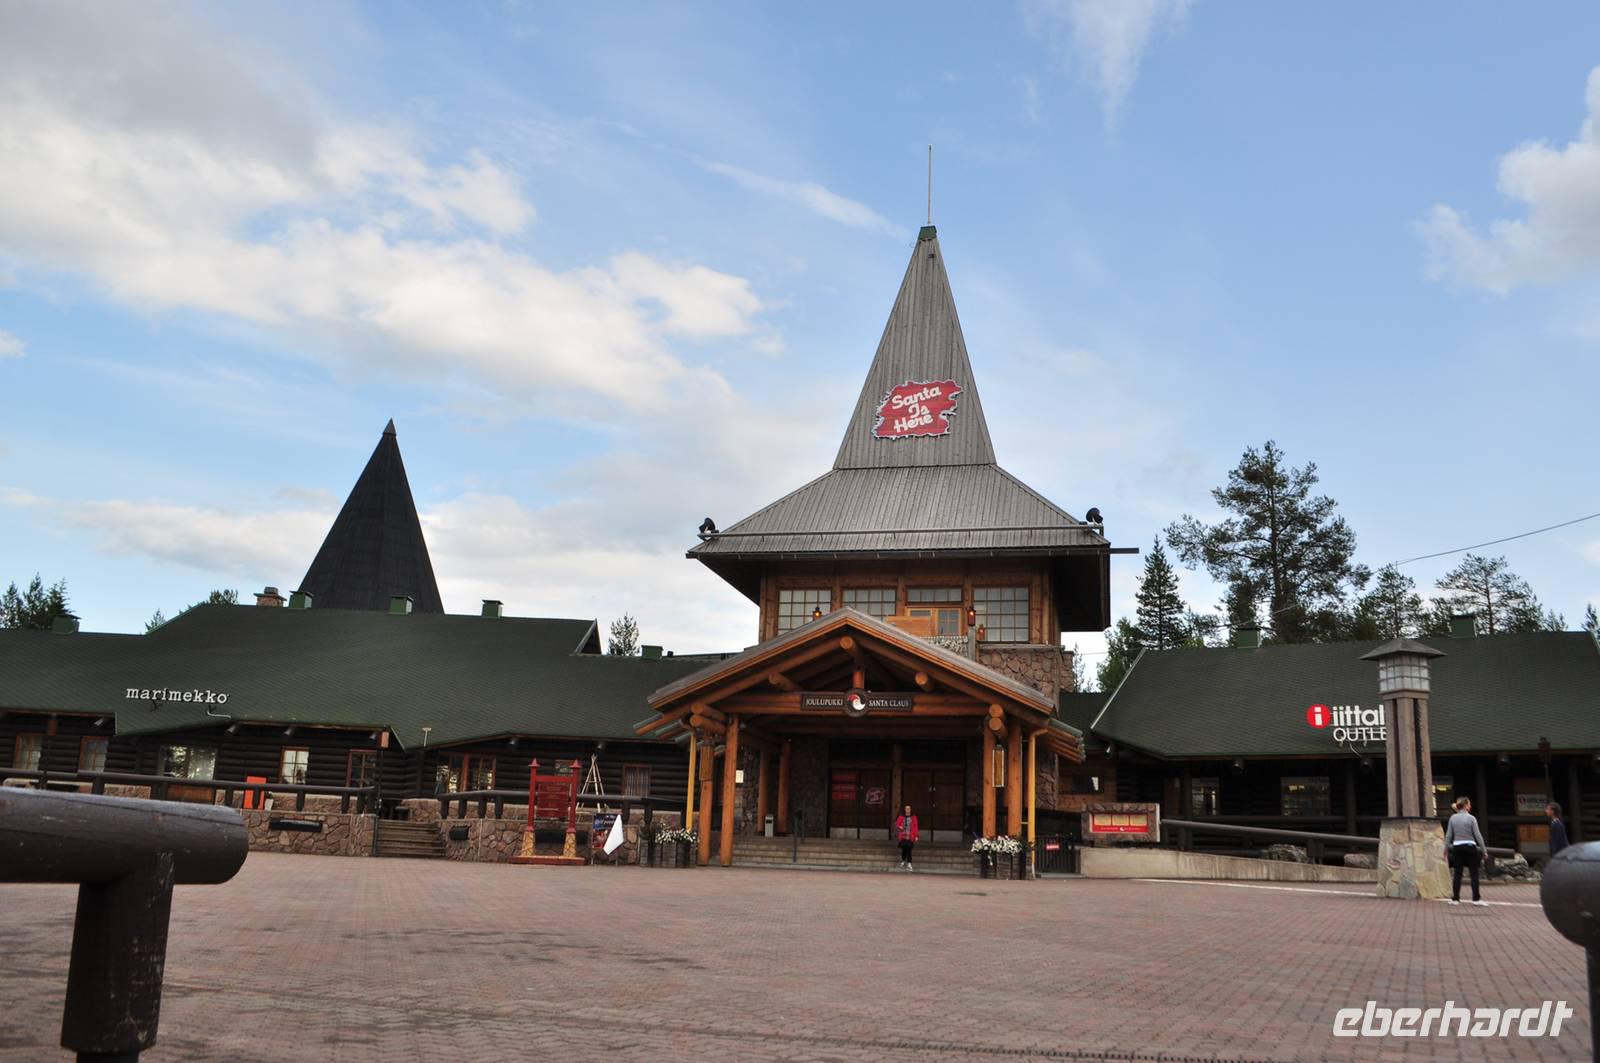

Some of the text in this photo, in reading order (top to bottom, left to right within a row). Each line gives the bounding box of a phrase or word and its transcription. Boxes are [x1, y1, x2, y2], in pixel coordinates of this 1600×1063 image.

[891, 386, 942, 409] Santa
[908, 403, 930, 418] Is
[894, 414, 933, 432] Here
[125, 687, 228, 704] marimekko
[805, 698, 909, 708] JOULUPUKKI SANTA CLAUS
[1332, 704, 1385, 726] iittal
[1333, 727, 1387, 742] OUTLE
